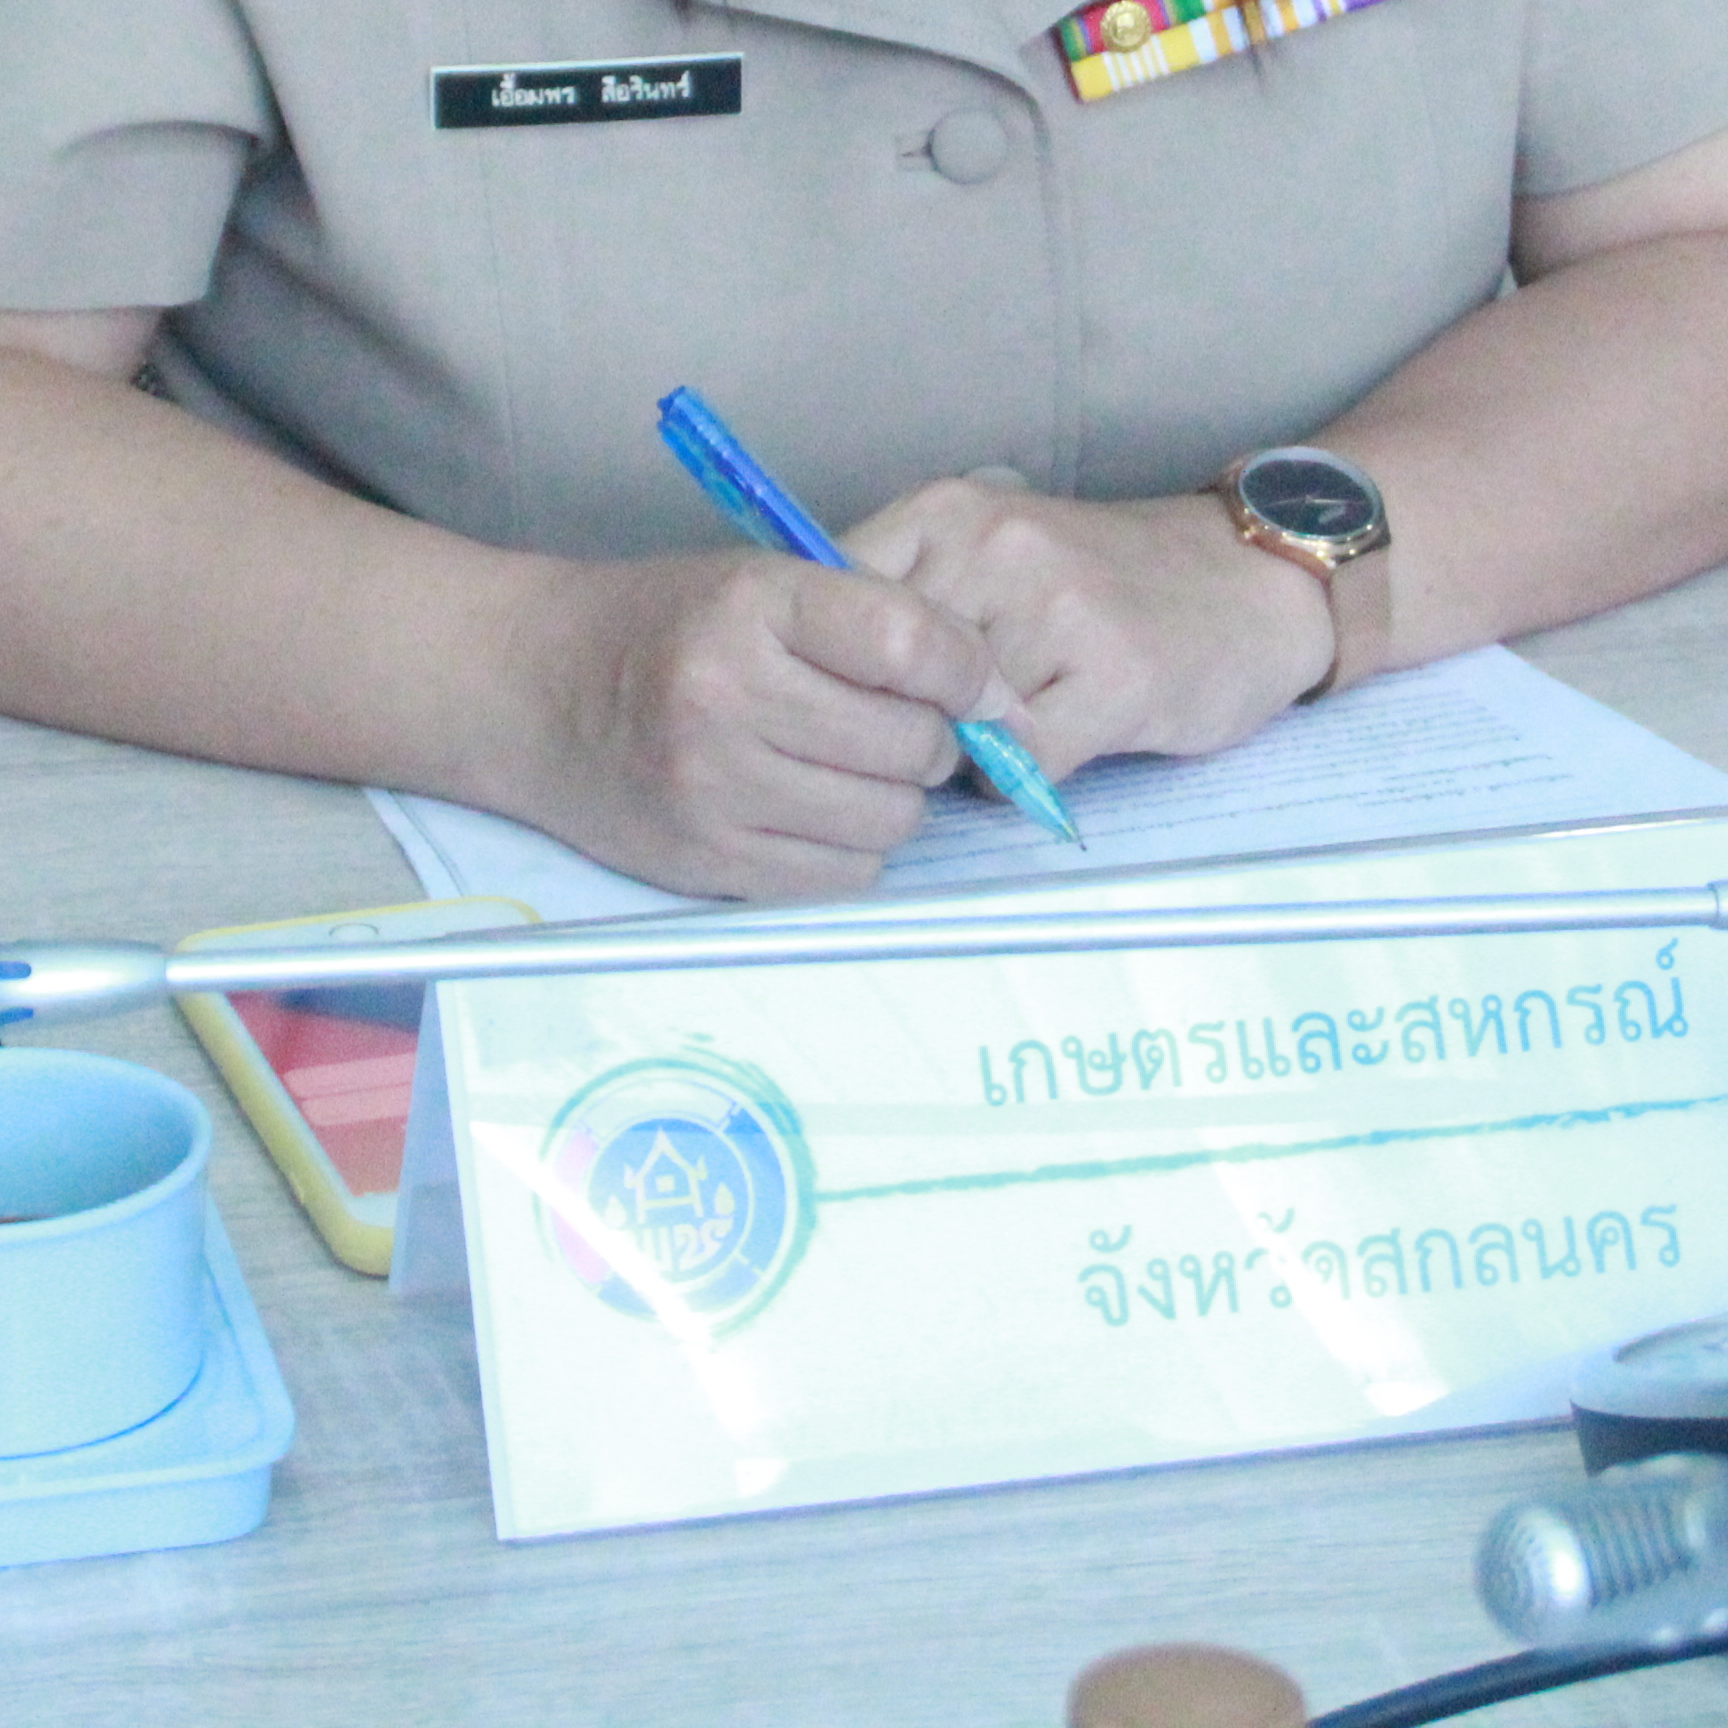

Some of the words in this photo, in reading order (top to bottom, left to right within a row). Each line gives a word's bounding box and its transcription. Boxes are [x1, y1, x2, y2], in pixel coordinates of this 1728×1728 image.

[977, 937, 1689, 1107] เกษตรและสหกรณ์
